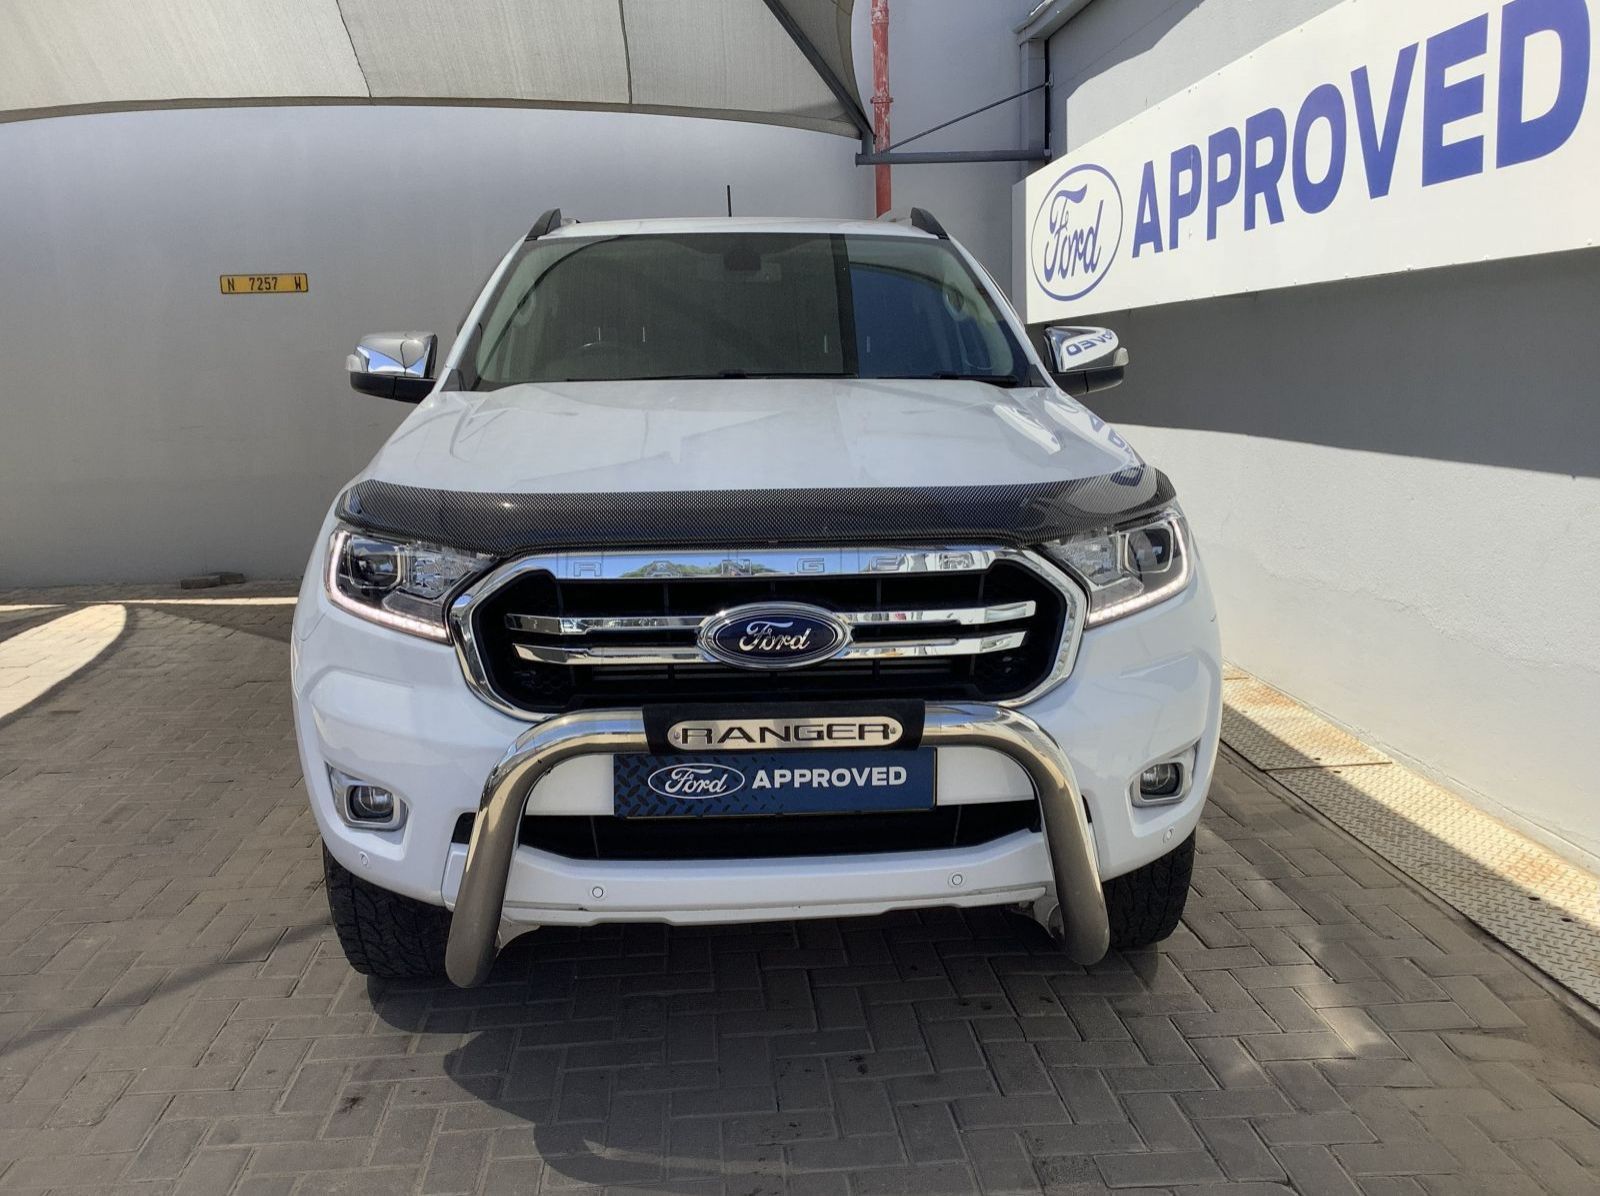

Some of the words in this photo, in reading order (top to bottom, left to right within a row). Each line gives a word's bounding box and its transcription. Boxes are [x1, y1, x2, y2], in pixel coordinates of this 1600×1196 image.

[1044, 184, 1104, 283] Ford
[1132, 0, 1591, 259] APPROVED
[227, 277, 235, 291] N
[249, 276, 278, 291] 7257
[573, 551, 975, 578] RANGER
[739, 620, 812, 651] Ford
[681, 723, 890, 745] RANGER
[664, 767, 729, 793] Ford
[752, 766, 907, 789] APPROVED
